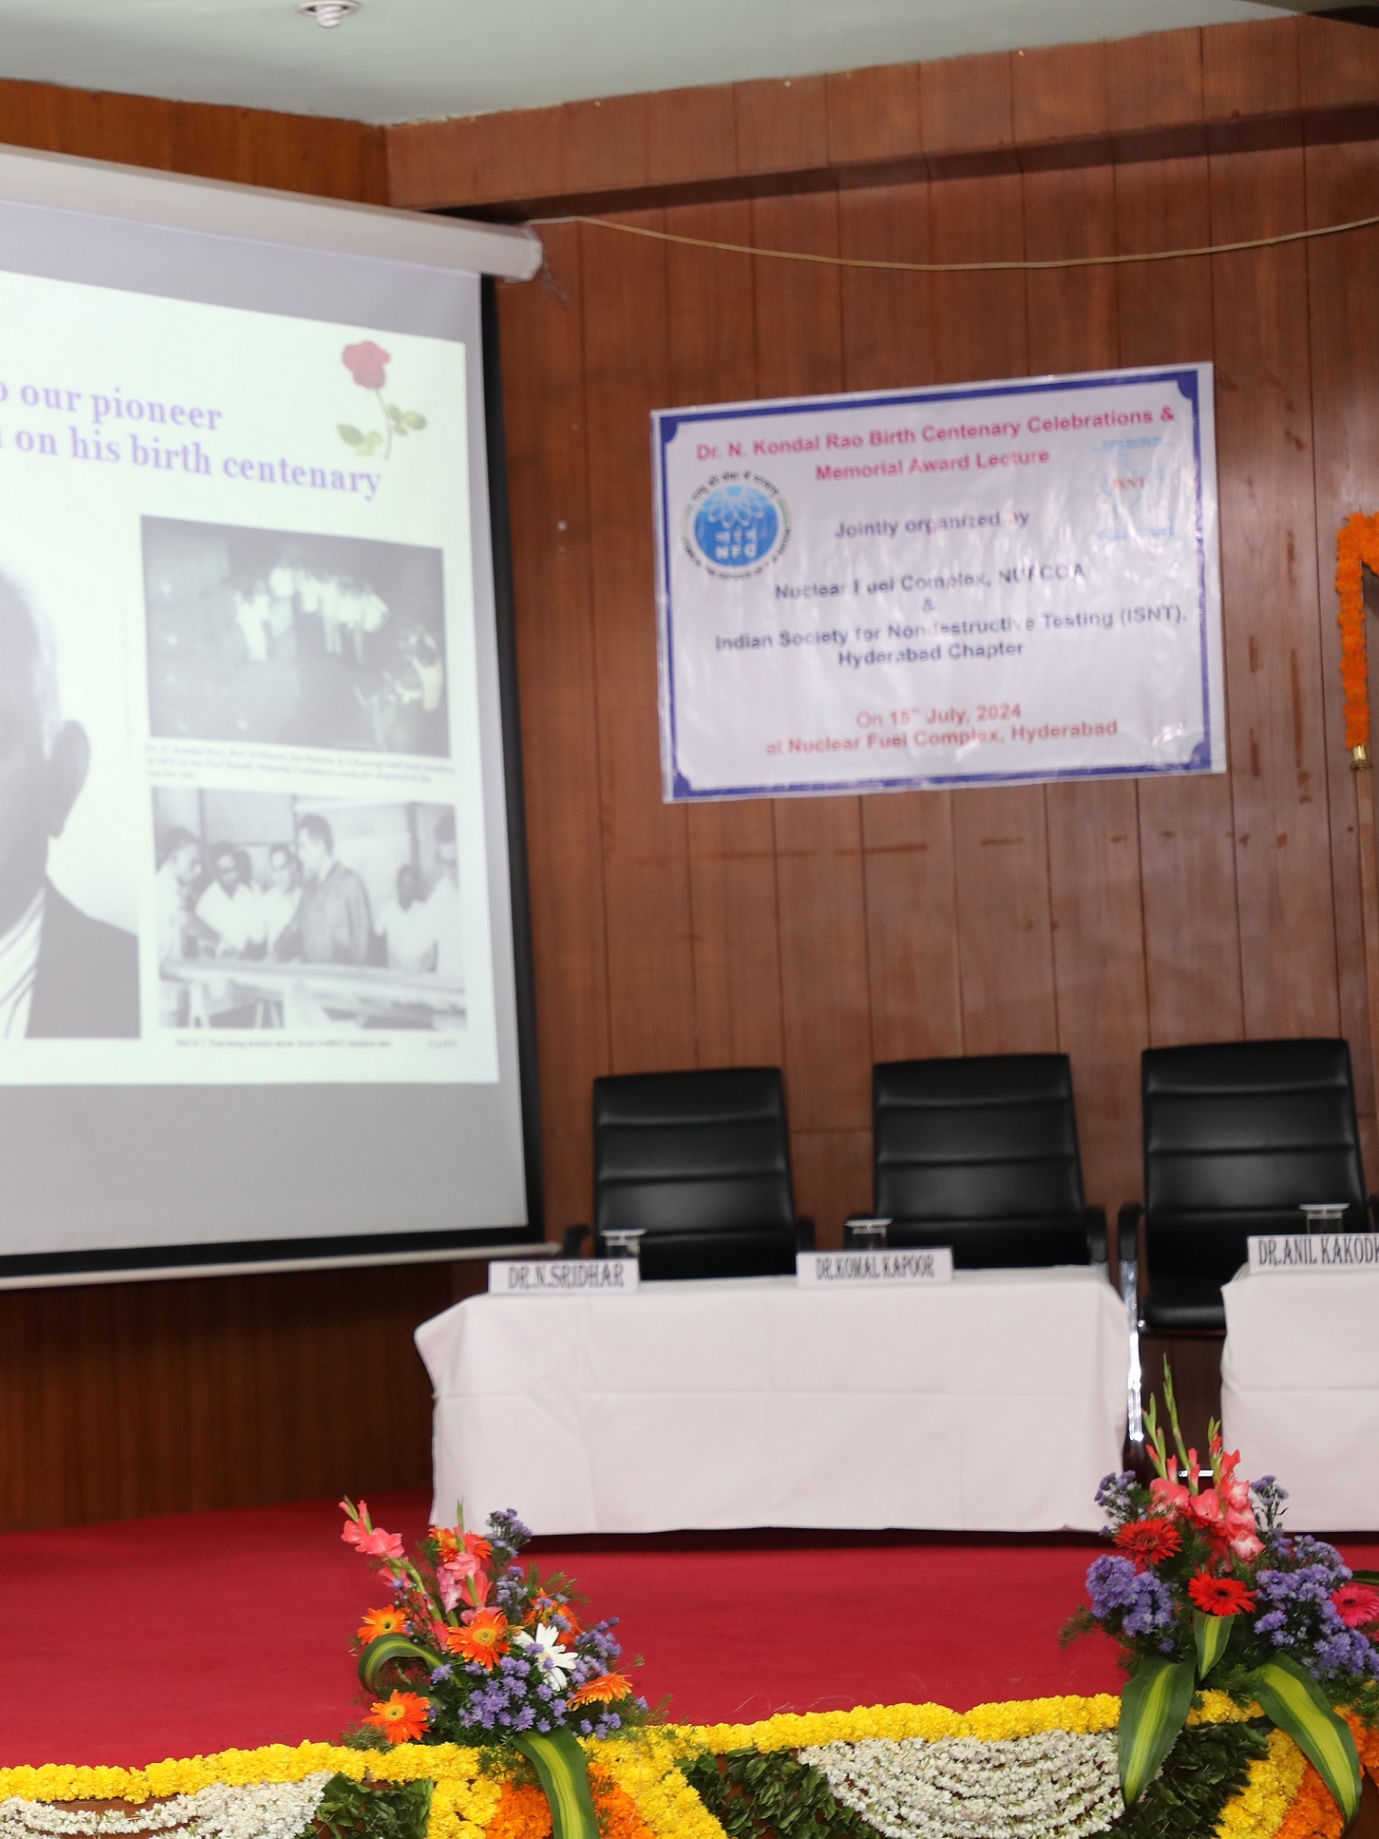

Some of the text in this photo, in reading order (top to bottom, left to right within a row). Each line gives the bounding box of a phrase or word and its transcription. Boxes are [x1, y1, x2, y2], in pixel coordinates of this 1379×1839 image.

[20, 380, 82, 414] our
[90, 387, 224, 431] pioneer
[753, 435, 821, 456] Kondal
[826, 432, 864, 448] Rao
[870, 427, 916, 447] Birth
[922, 420, 1022, 444] Centenary
[1027, 408, 1154, 434] Celebrations
[1160, 405, 1175, 422] &
[15, 430, 59, 457] on
[70, 425, 122, 464] his
[130, 432, 213, 476] birth
[222, 455, 383, 502] centenary
[816, 450, 1050, 481] Memorial Award Lecture
[834, 521, 898, 540] Jointly
[905, 512, 1001, 536] organized
[775, 582, 845, 600] Nuclear
[854, 576, 894, 595] Fuel
[715, 633, 773, 652] Indian
[778, 627, 848, 649] Society
[855, 625, 881, 643] for
[1043, 610, 1114, 631] Testing
[838, 642, 1023, 671] Hyderabad Chapter
[856, 711, 883, 729] On
[976, 702, 1022, 722] 2024
[766, 719, 1118, 757] at Nuclear Fuel Complex, Hyderabad
[882, 1253, 935, 1278] KAPOOR
